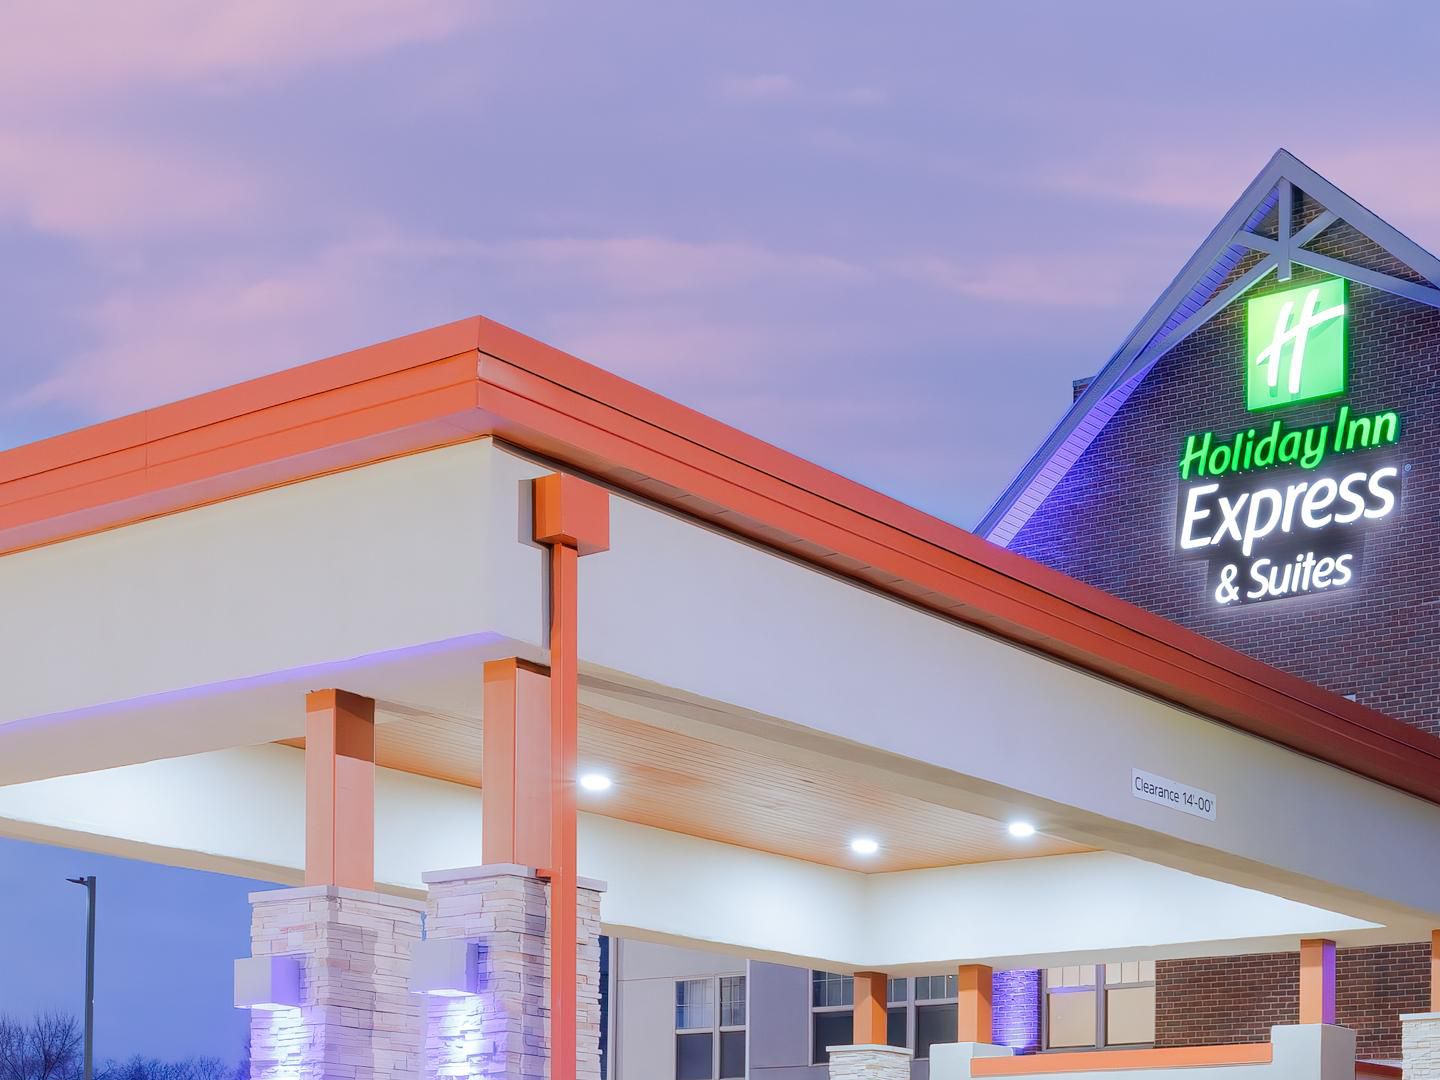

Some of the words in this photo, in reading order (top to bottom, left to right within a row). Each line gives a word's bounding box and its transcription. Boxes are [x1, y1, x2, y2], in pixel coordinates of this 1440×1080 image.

[1255, 289, 1346, 394] H
[1180, 420, 1328, 479] Holiday
[1333, 406, 1397, 452] Inn
[1180, 467, 1397, 556] Express
[1215, 564, 1239, 604] &
[1246, 552, 1353, 599] Suites
[1135, 776, 1180, 803] Clearance
